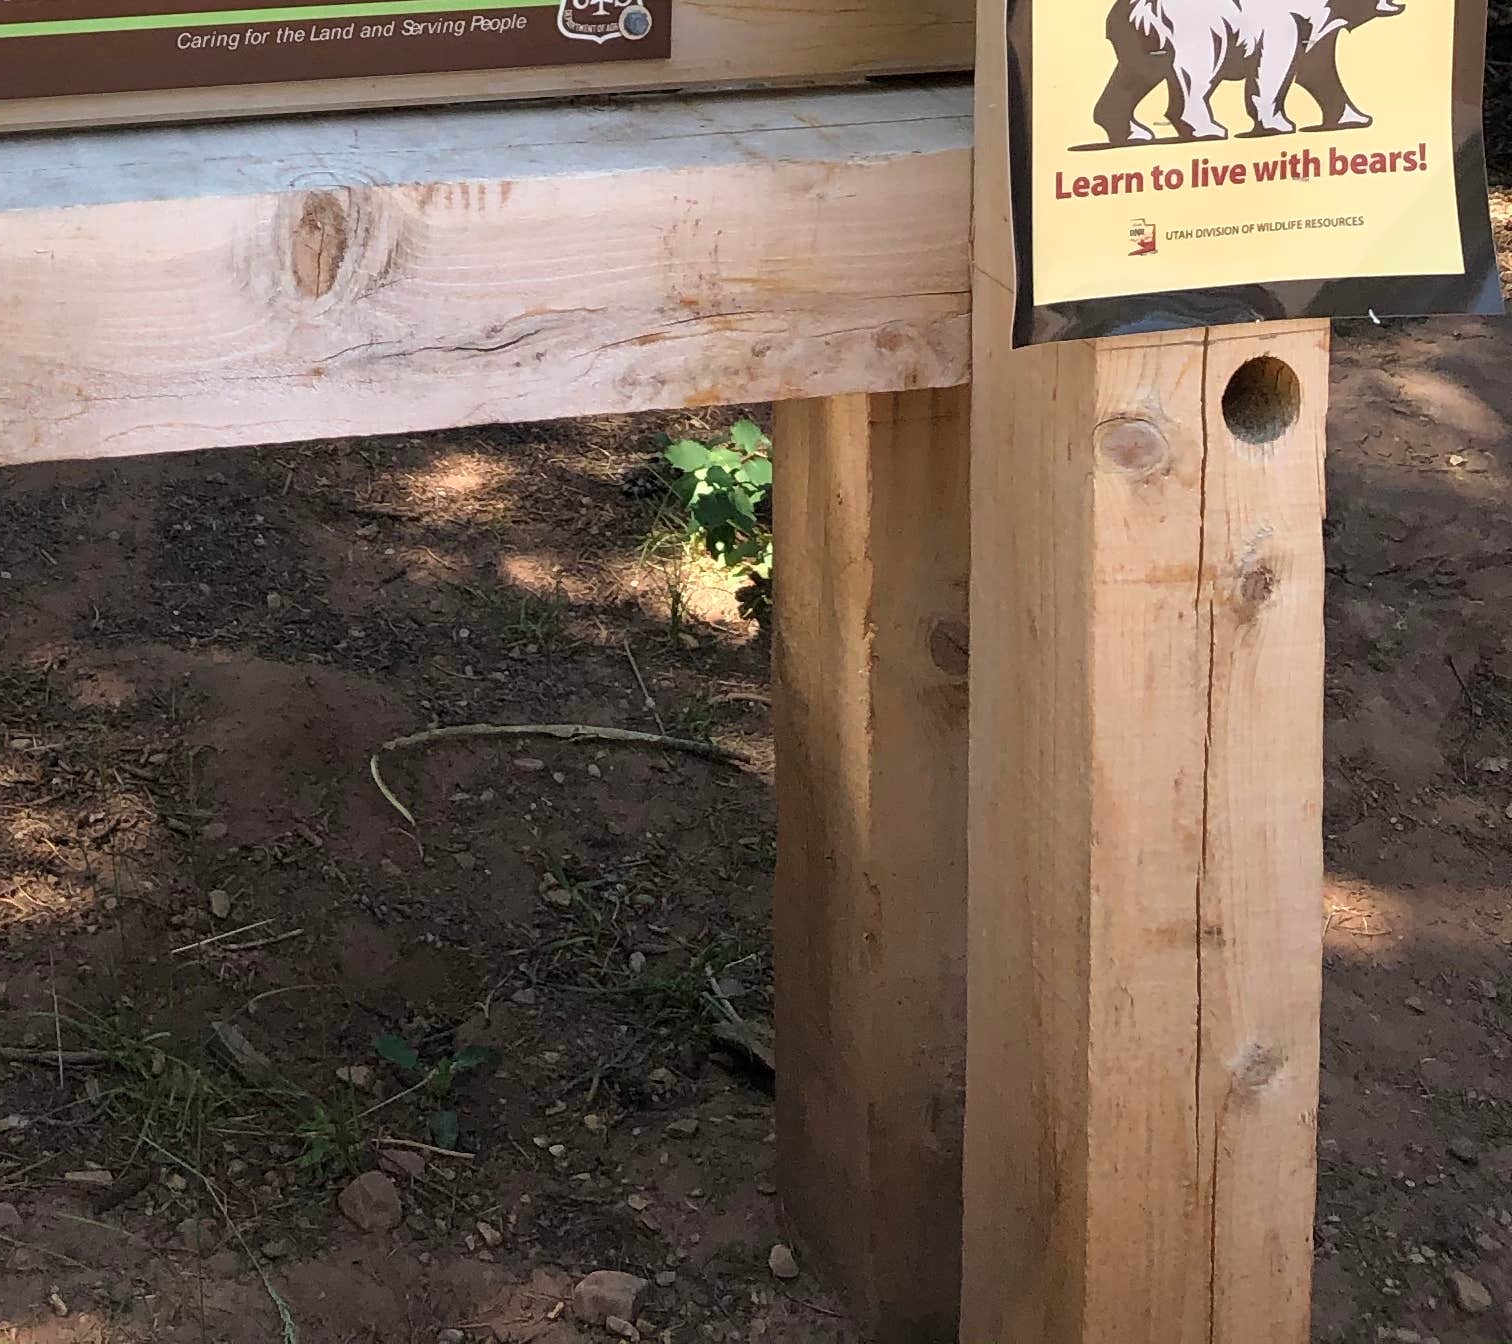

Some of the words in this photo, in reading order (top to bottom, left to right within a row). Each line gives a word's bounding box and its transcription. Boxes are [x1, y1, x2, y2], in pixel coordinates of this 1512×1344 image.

[176, 30, 240, 50] Caring
[244, 28, 271, 45] for
[275, 26, 306, 43] the
[309, 22, 355, 41] Land
[359, 20, 395, 38] and
[400, 17, 466, 36] Serving
[469, 13, 527, 33] People
[1054, 171, 1144, 199] Learn
[1149, 165, 1184, 191] to
[1190, 158, 1247, 187] live
[1252, 150, 1321, 181] with
[1328, 143, 1427, 175] bears!
[1164, 229, 1193, 240] UTAH
[1194, 225, 1240, 238] DIVISION
[1240, 223, 1255, 234] OF
[1256, 219, 1303, 232] WILDLIFE
[1304, 215, 1365, 228] RESOURCES
